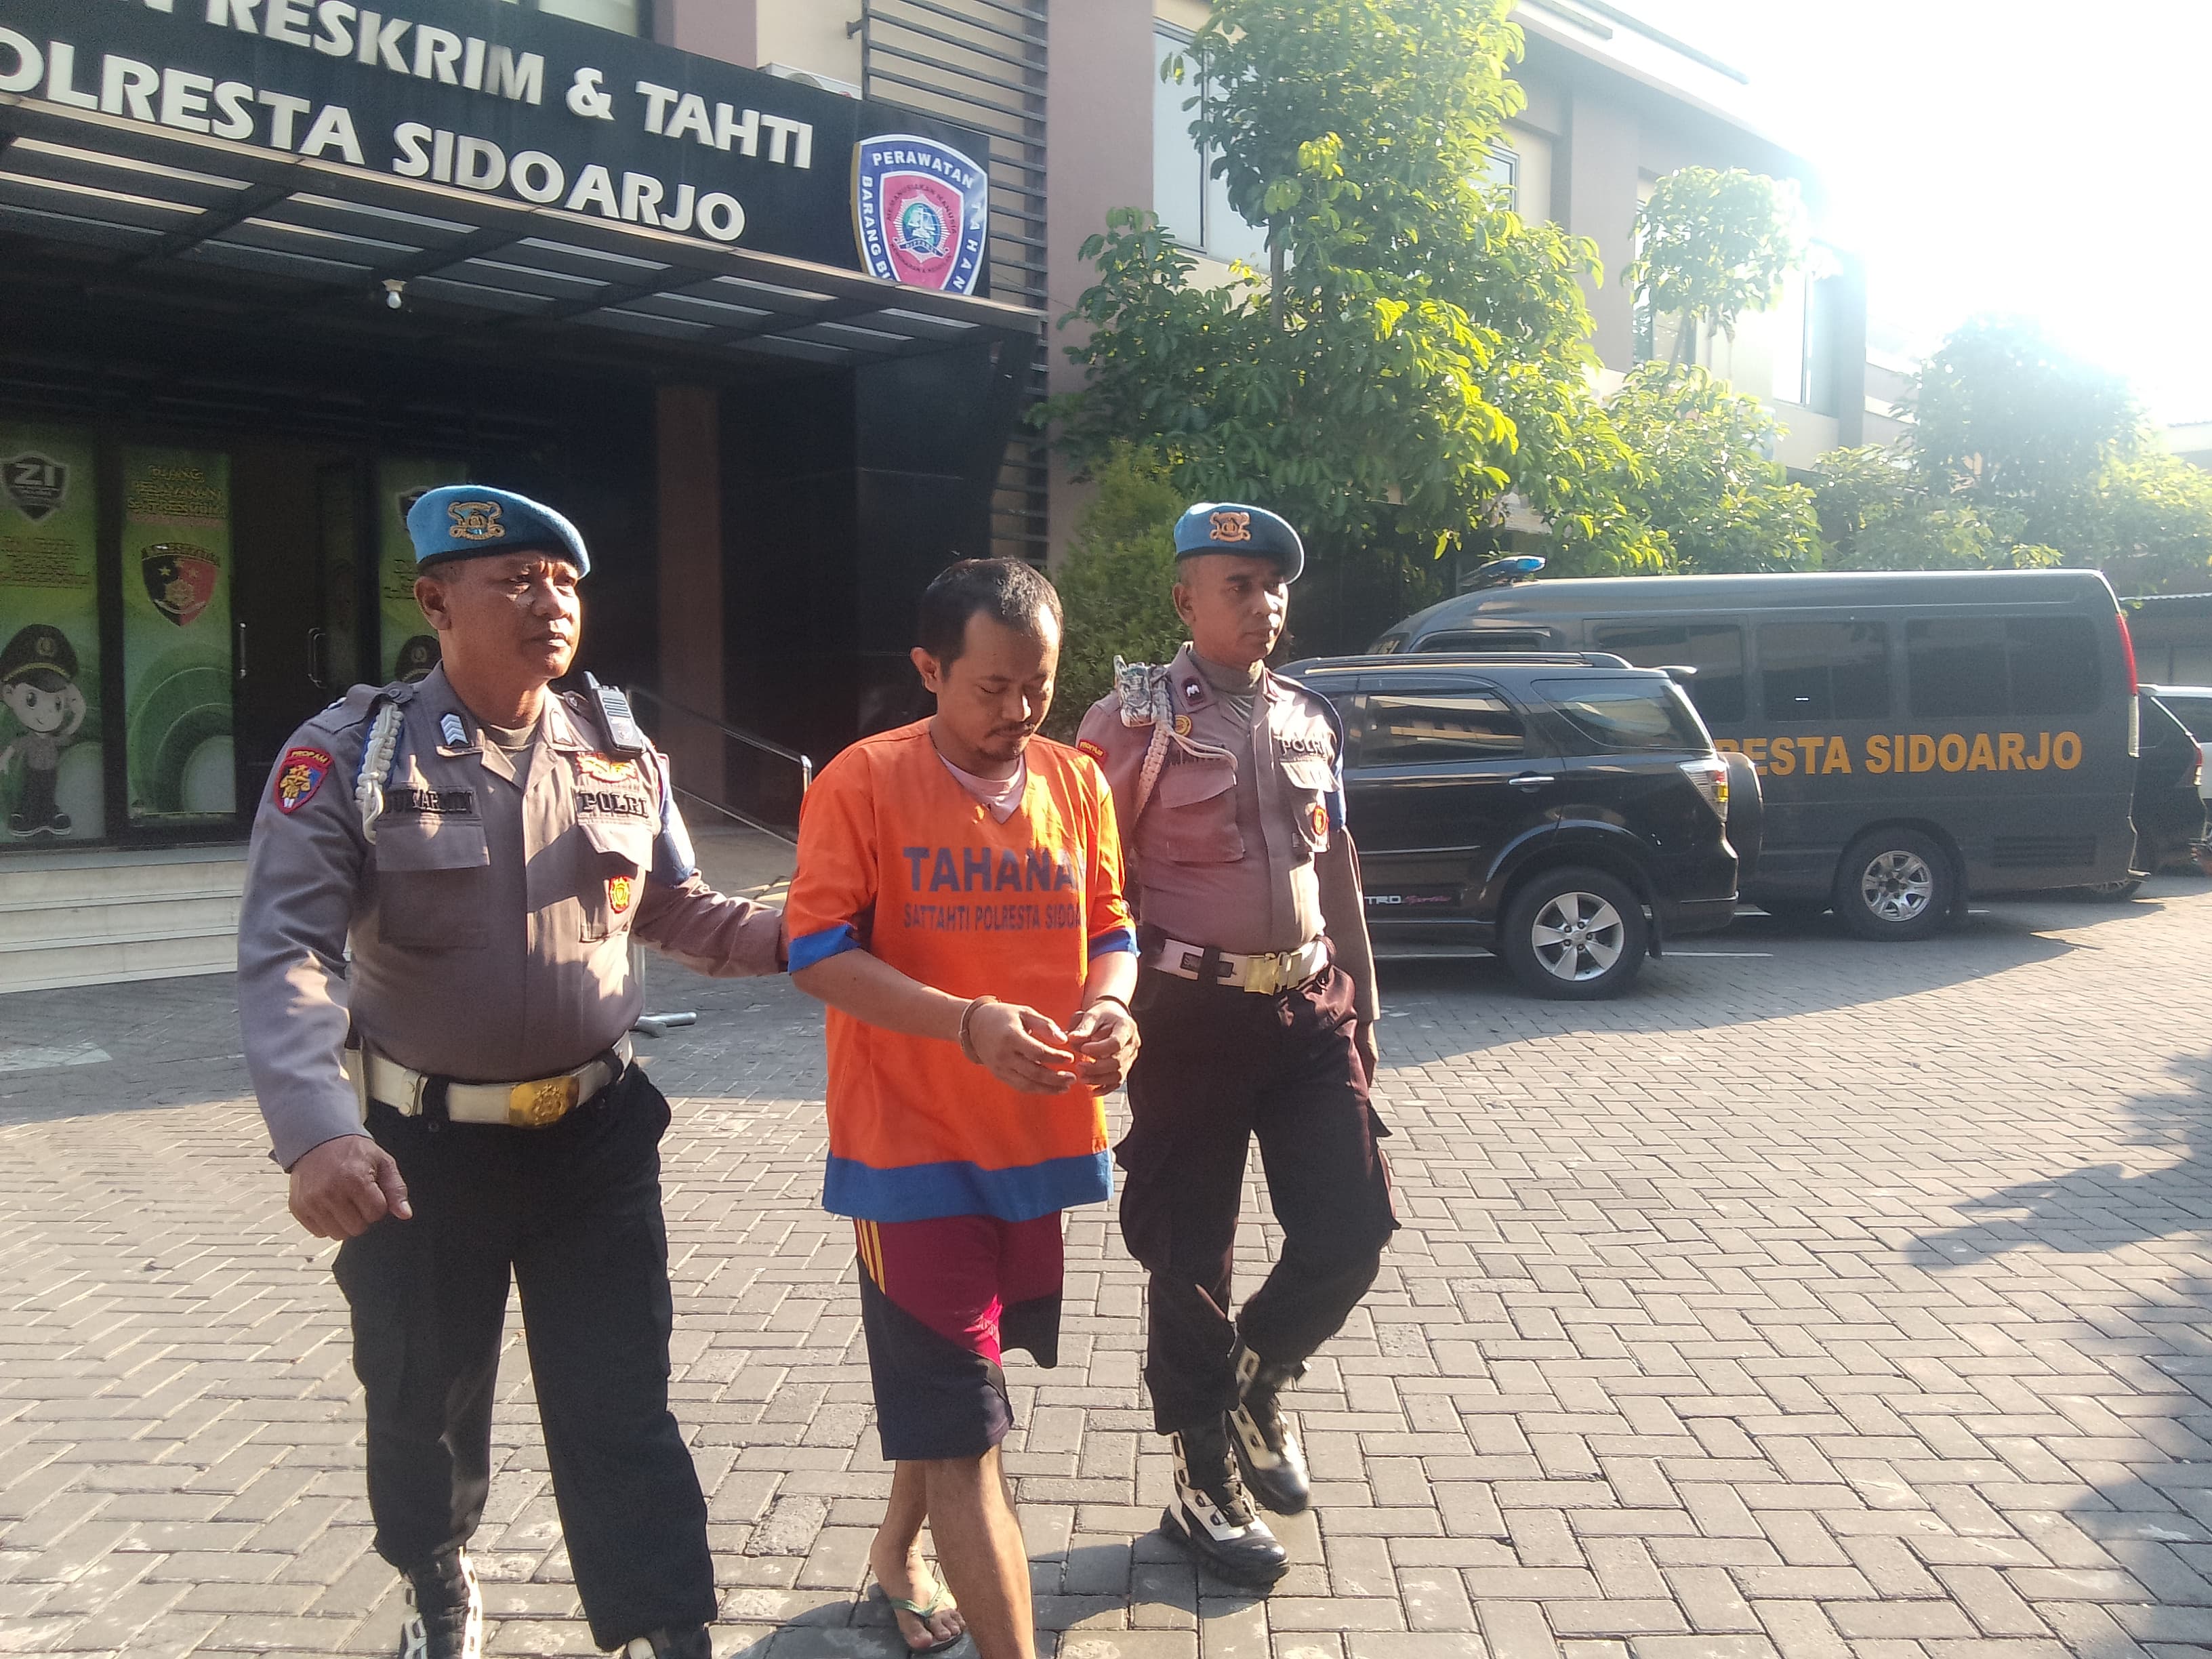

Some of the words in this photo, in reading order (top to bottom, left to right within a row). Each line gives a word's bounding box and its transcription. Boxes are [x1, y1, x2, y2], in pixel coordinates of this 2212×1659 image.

[566, 67, 615, 121] &
[635, 81, 813, 169] TAHTI
[392, 121, 745, 241] SIDOARJO
[872, 150, 975, 189] PERAWATAN
[861, 176, 882, 256] BARANG
[1864, 731, 2083, 774] SIDOARJO
[579, 790, 650, 818] POLRI
[975, 904, 1042, 933] POLRESTA
[1364, 895, 1402, 905] TRD
